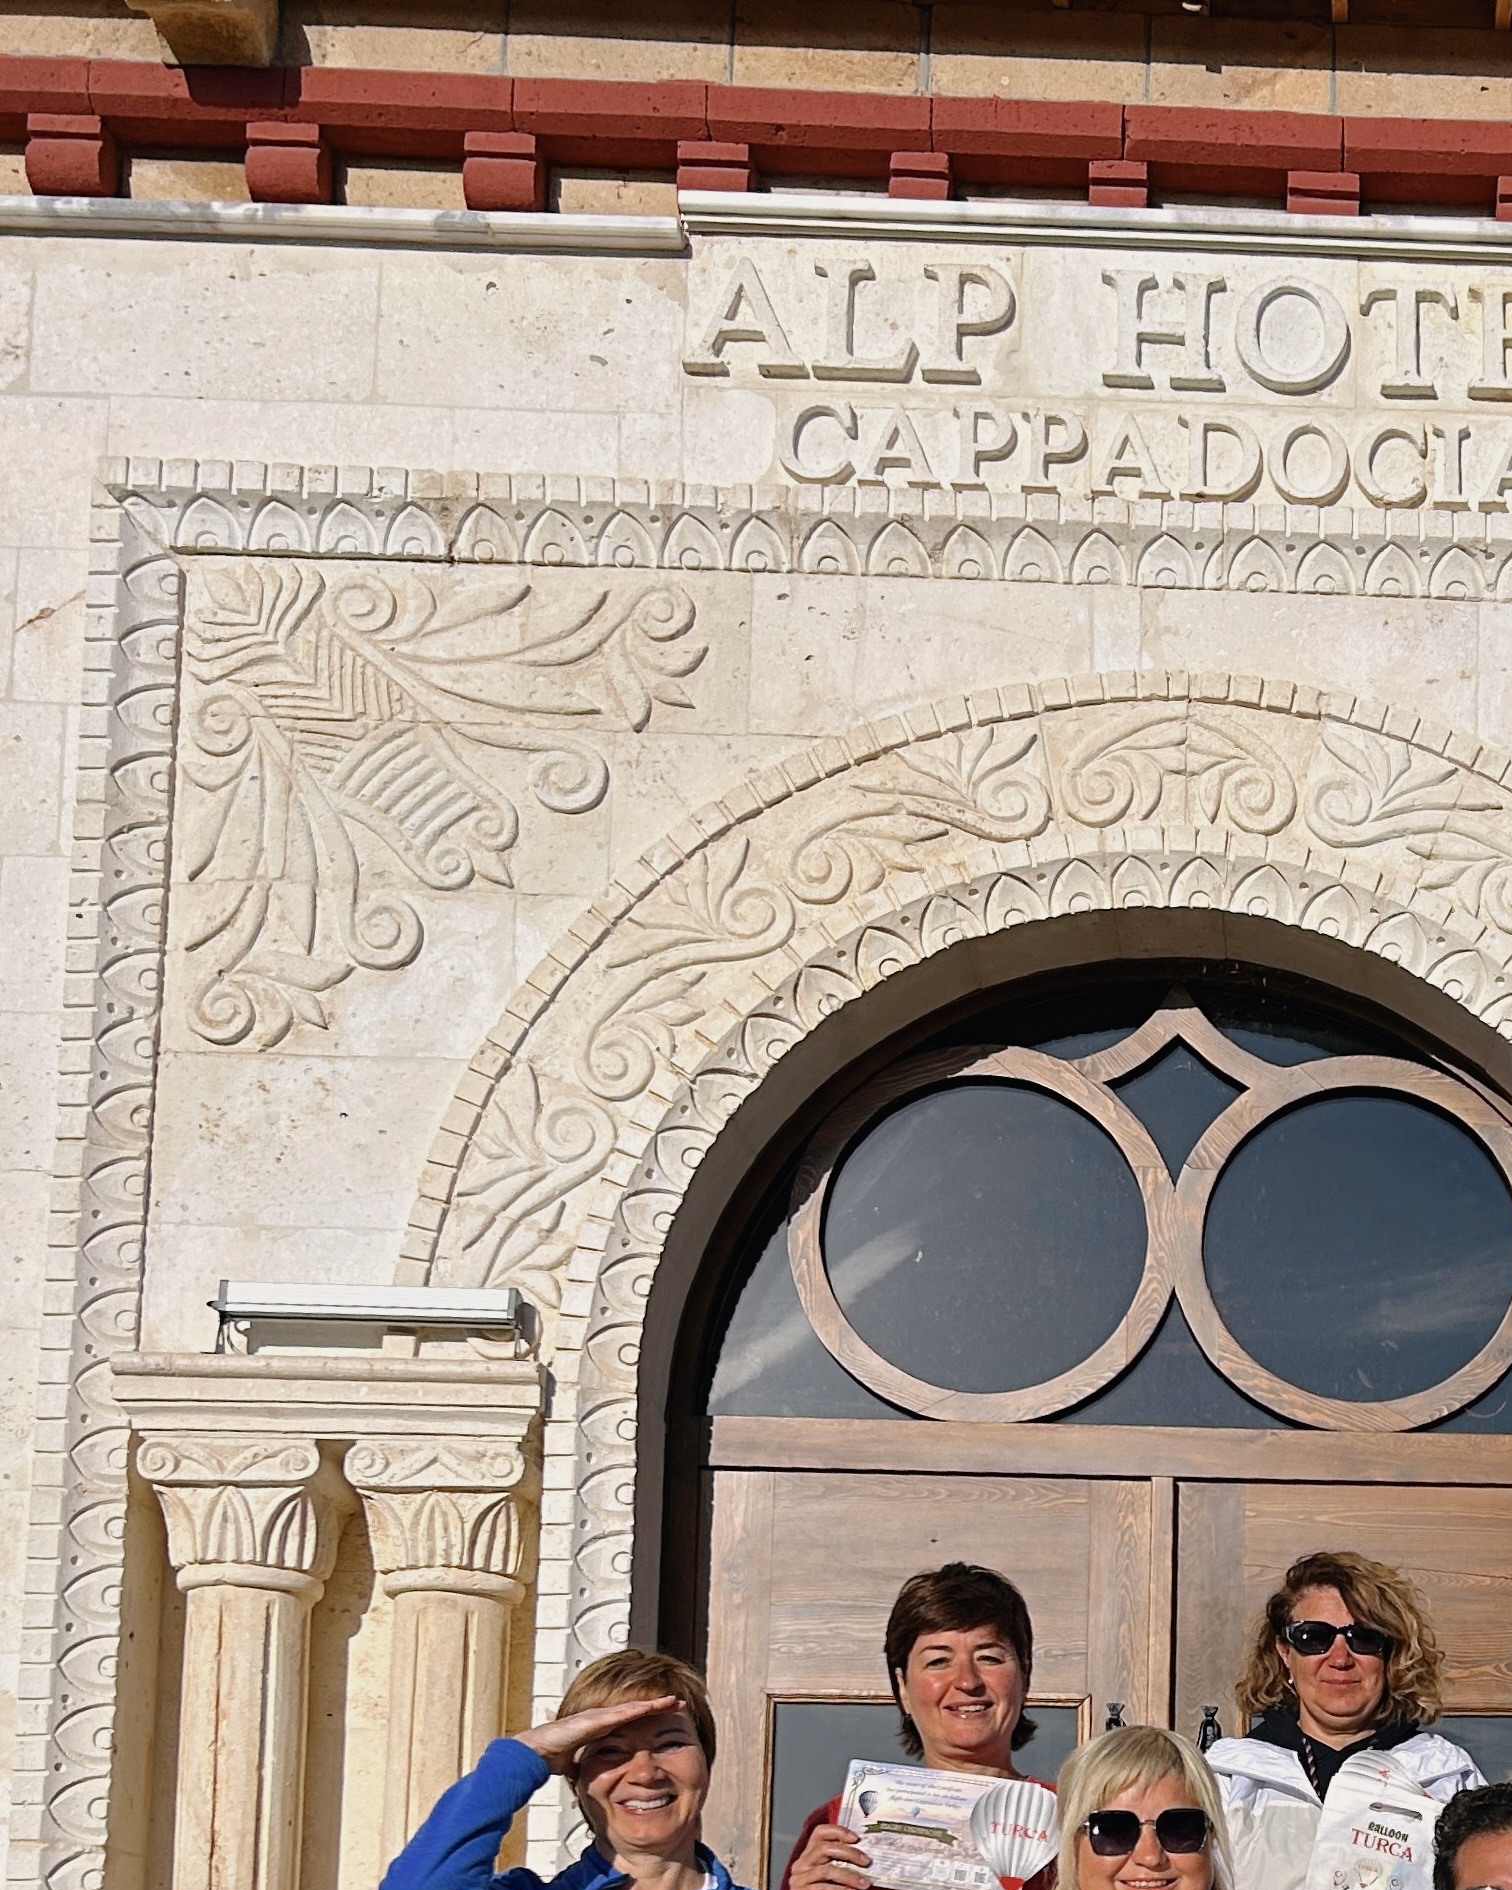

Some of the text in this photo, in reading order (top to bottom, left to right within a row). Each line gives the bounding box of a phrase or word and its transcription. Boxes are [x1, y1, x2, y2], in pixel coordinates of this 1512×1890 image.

[683, 256, 1017, 386] ALP
[1351, 1828, 1414, 1863] TURCA
[1368, 1821, 1409, 1843] BALLOON
